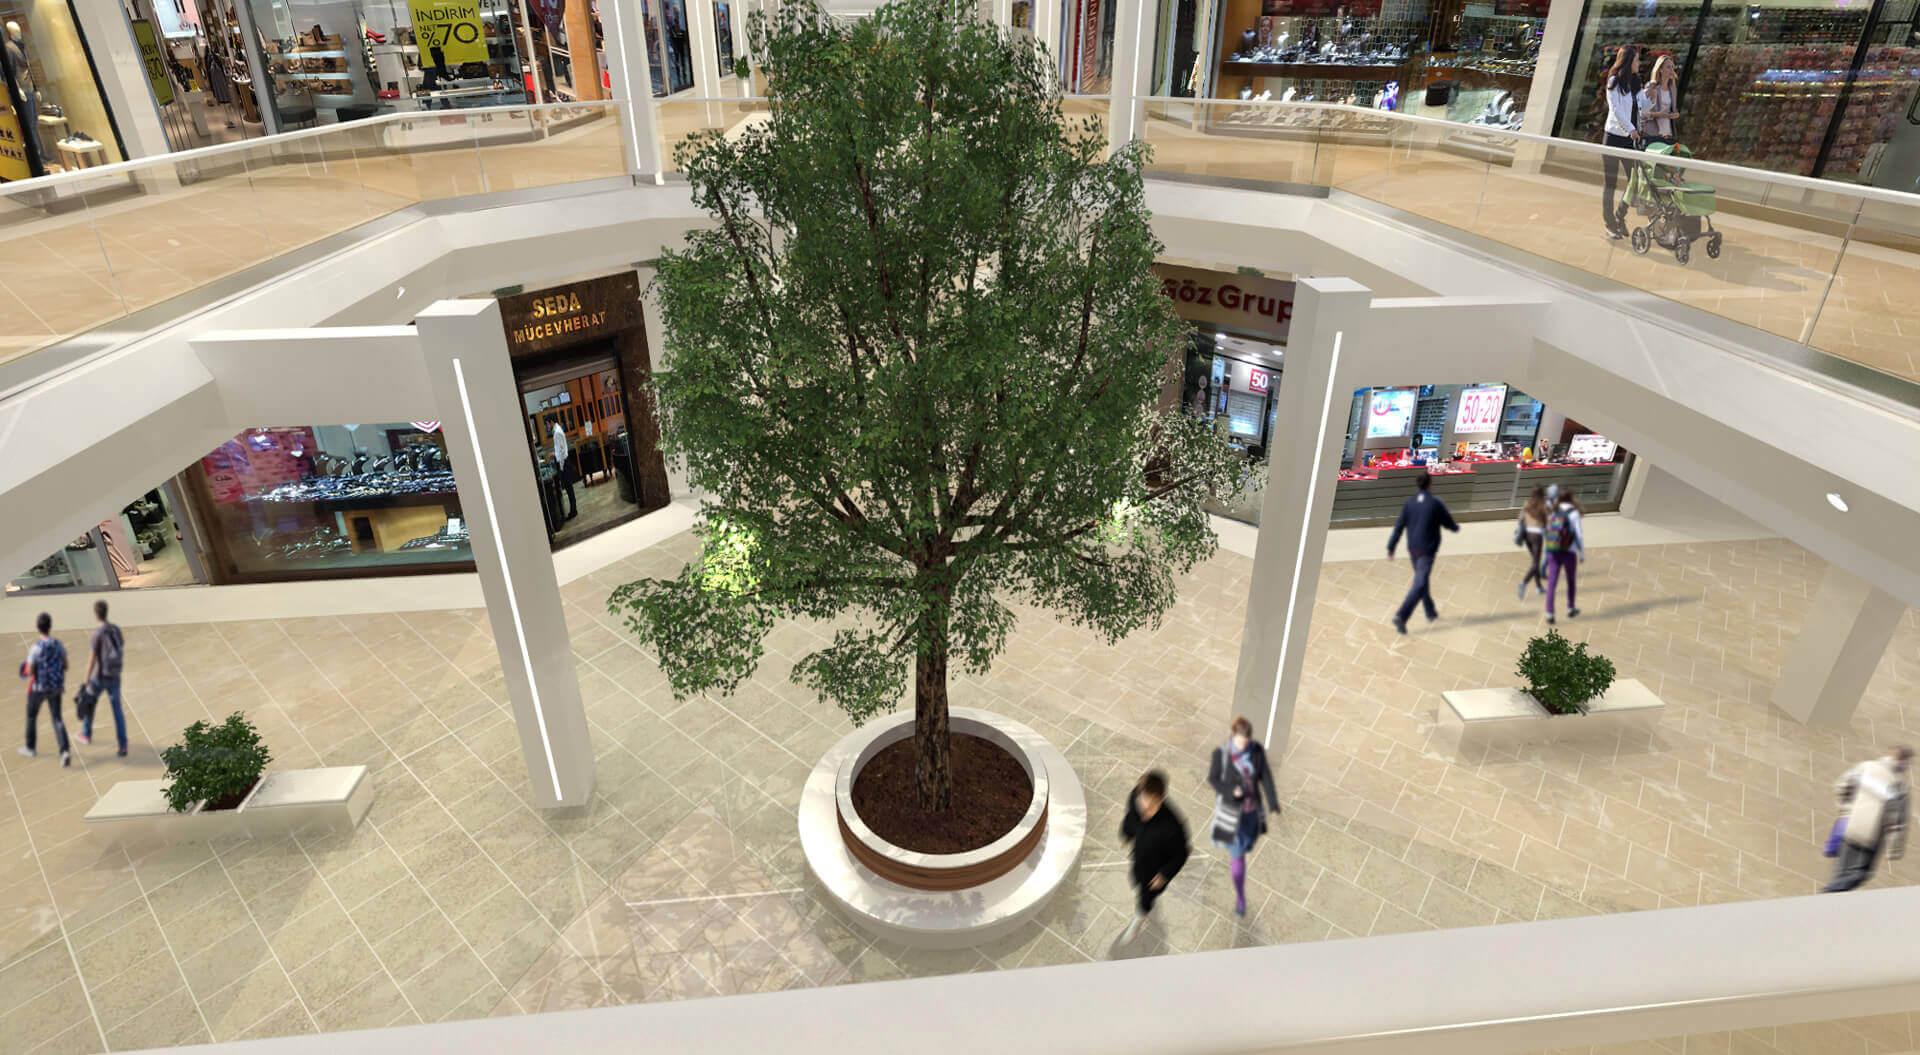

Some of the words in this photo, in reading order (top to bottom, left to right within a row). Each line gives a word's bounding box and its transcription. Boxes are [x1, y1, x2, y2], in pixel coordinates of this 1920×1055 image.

[416, 6, 476, 23] İNDİRİM
[419, 24, 437, 33] NET
[532, 291, 582, 319] SEDA
[1217, 284, 1294, 324] Grup
[513, 311, 606, 345] MÜCEVHERAT
[1250, 371, 1269, 389] 50
